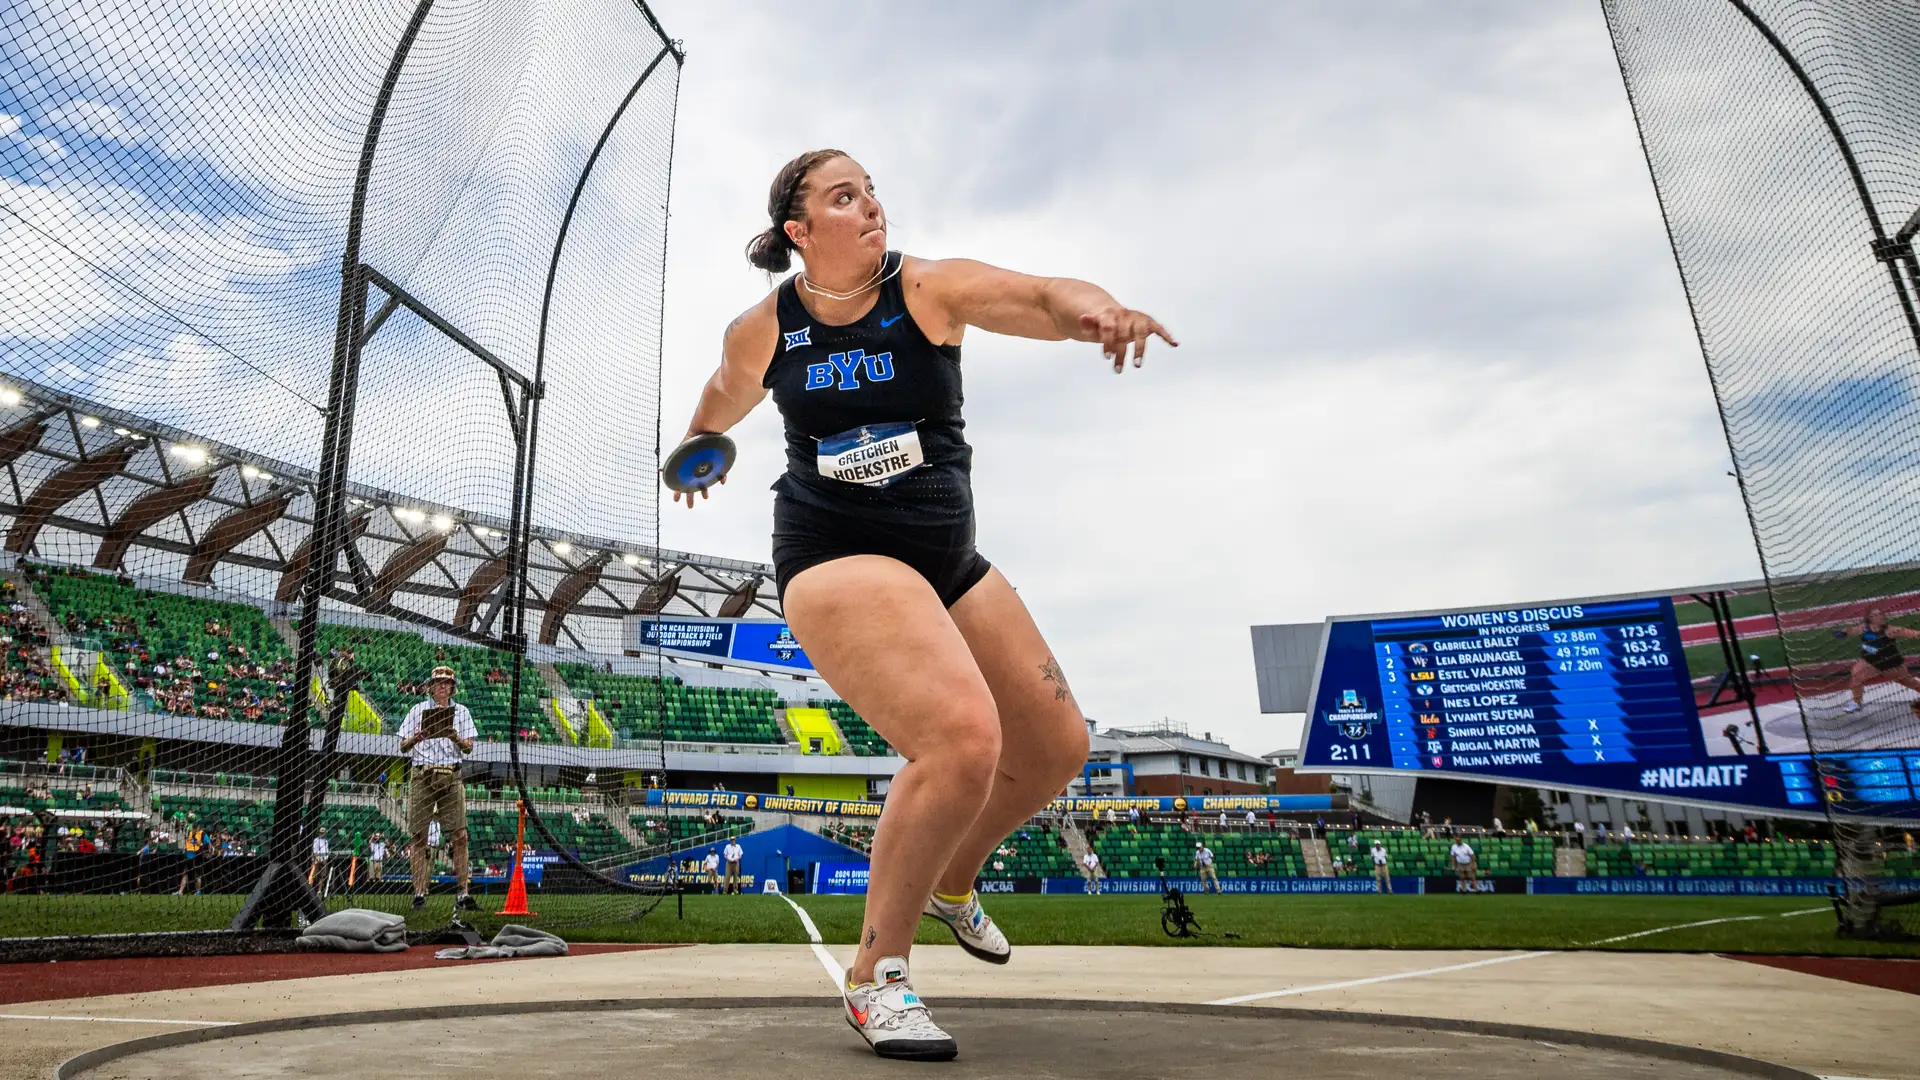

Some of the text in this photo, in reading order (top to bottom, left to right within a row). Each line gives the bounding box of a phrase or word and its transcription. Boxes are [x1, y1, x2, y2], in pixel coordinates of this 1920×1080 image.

[805, 349, 895, 391] BYU
[838, 439, 900, 466] GRETCHEN
[833, 453, 911, 481] HOEKSTRE
[1442, 606, 1584, 628] WOMEN'S DISCUS
[687, 625, 715, 633] DIVISION
[1478, 623, 1550, 636] IN PROGRESS
[659, 639, 711, 647] CHAMPIONSHIPS
[1384, 644, 1391, 655] 1
[1484, 637, 1520, 649] BAILEY
[1553, 631, 1597, 643] 52.88m
[1620, 624, 1658, 638] 173-6
[1386, 659, 1394, 669] 2
[1459, 651, 1523, 664] BRAUNAGEL
[1556, 646, 1600, 658] 49.75m
[1623, 640, 1661, 653] 163-2
[1389, 654, 1669, 682] 3 LSU ESTEL VALEANU 47.20m 154-10
[1481, 679, 1526, 692] HOEKSTRE
[1443, 695, 1518, 709] INES LOPEZ
[1329, 712, 1378, 721] CHAMPIONSHIPS
[1487, 724, 1536, 737] IHEOMA
[1494, 737, 1540, 750] MARTIN
[1330, 743, 1371, 761] 2:11
[1492, 753, 1542, 765] WEPIWE
[1640, 765, 1748, 788] #NCAATF
[711, 793, 738, 806] FIELD
[1203, 797, 1268, 810] CHAMPIONS
[765, 797, 881, 816] UNIVERSITY OF OREGON
[835, 870, 850, 878] 2024
[981, 881, 1015, 892] NCAA
